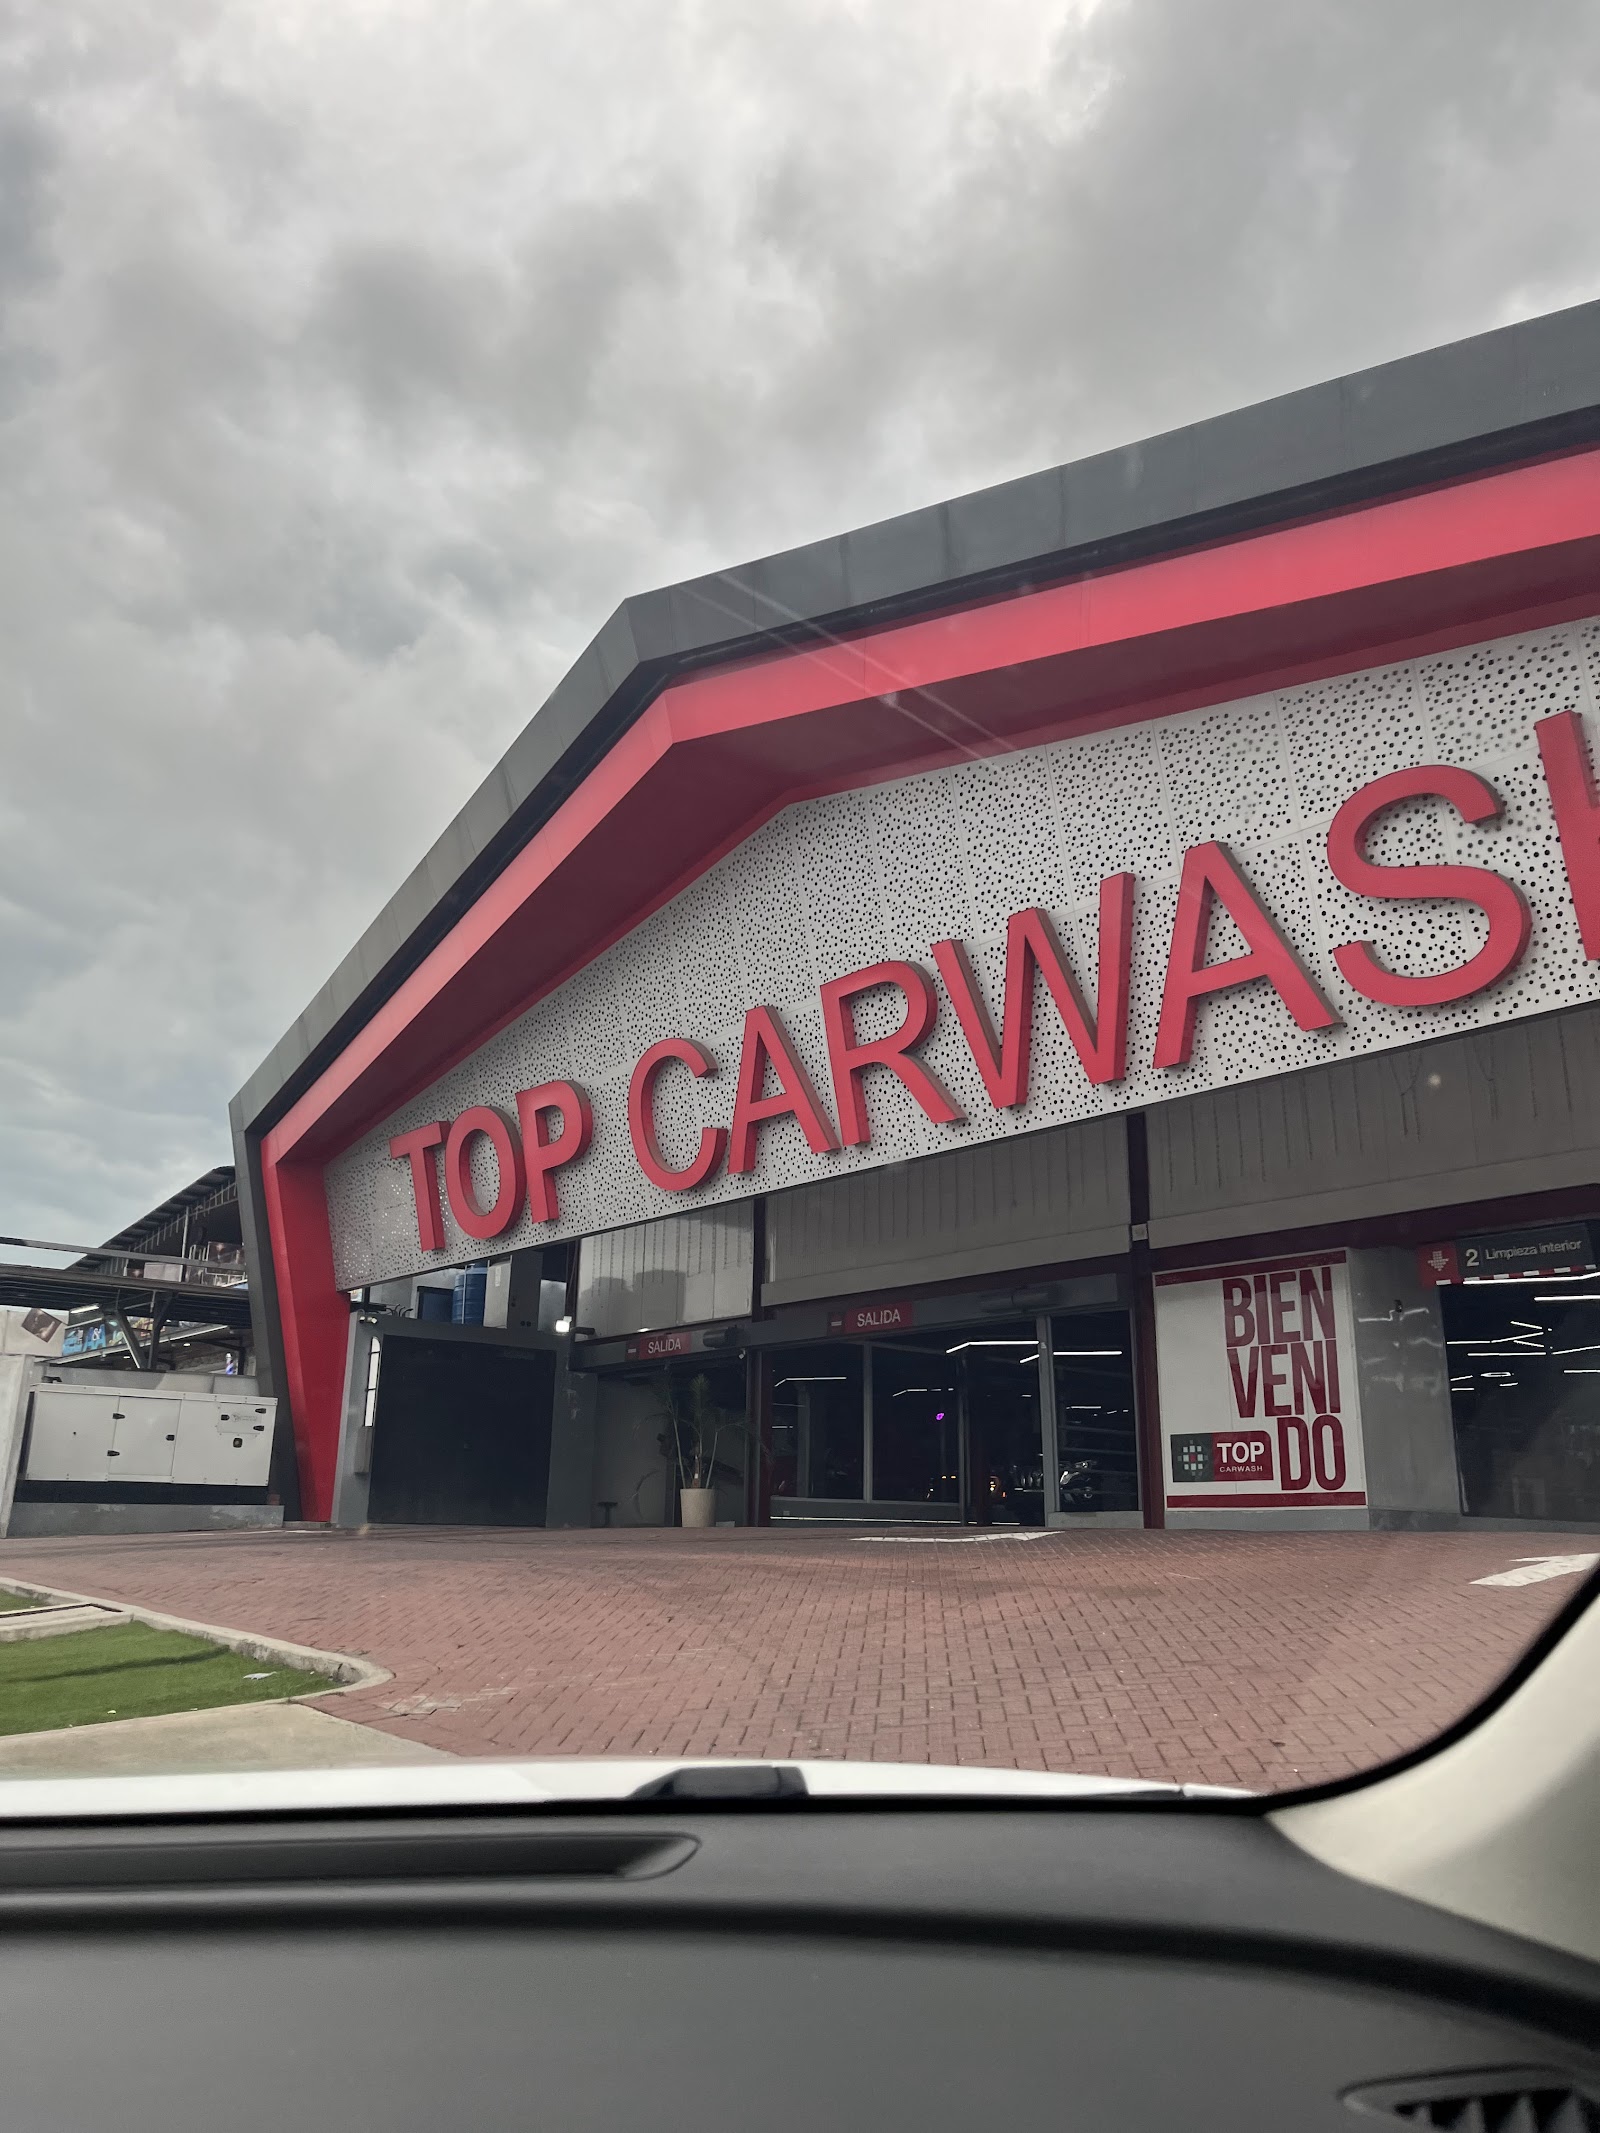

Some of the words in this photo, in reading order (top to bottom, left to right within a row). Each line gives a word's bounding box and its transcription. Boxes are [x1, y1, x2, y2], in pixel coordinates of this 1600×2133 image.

[389, 1079, 592, 1252] TOP
[1465, 1249, 1479, 1267] 2
[1485, 1246, 1537, 1260] Limpieza
[1539, 1240, 1582, 1254] interior
[857, 1309, 901, 1327] SALIDA
[1222, 1266, 1336, 1347] BIEN
[648, 1337, 681, 1354] SALIDA
[1227, 1340, 1341, 1418] VENI
[1216, 1441, 1265, 1463] TOP
[1277, 1414, 1346, 1491] DO
[1219, 1465, 1263, 1473] CARWASH
